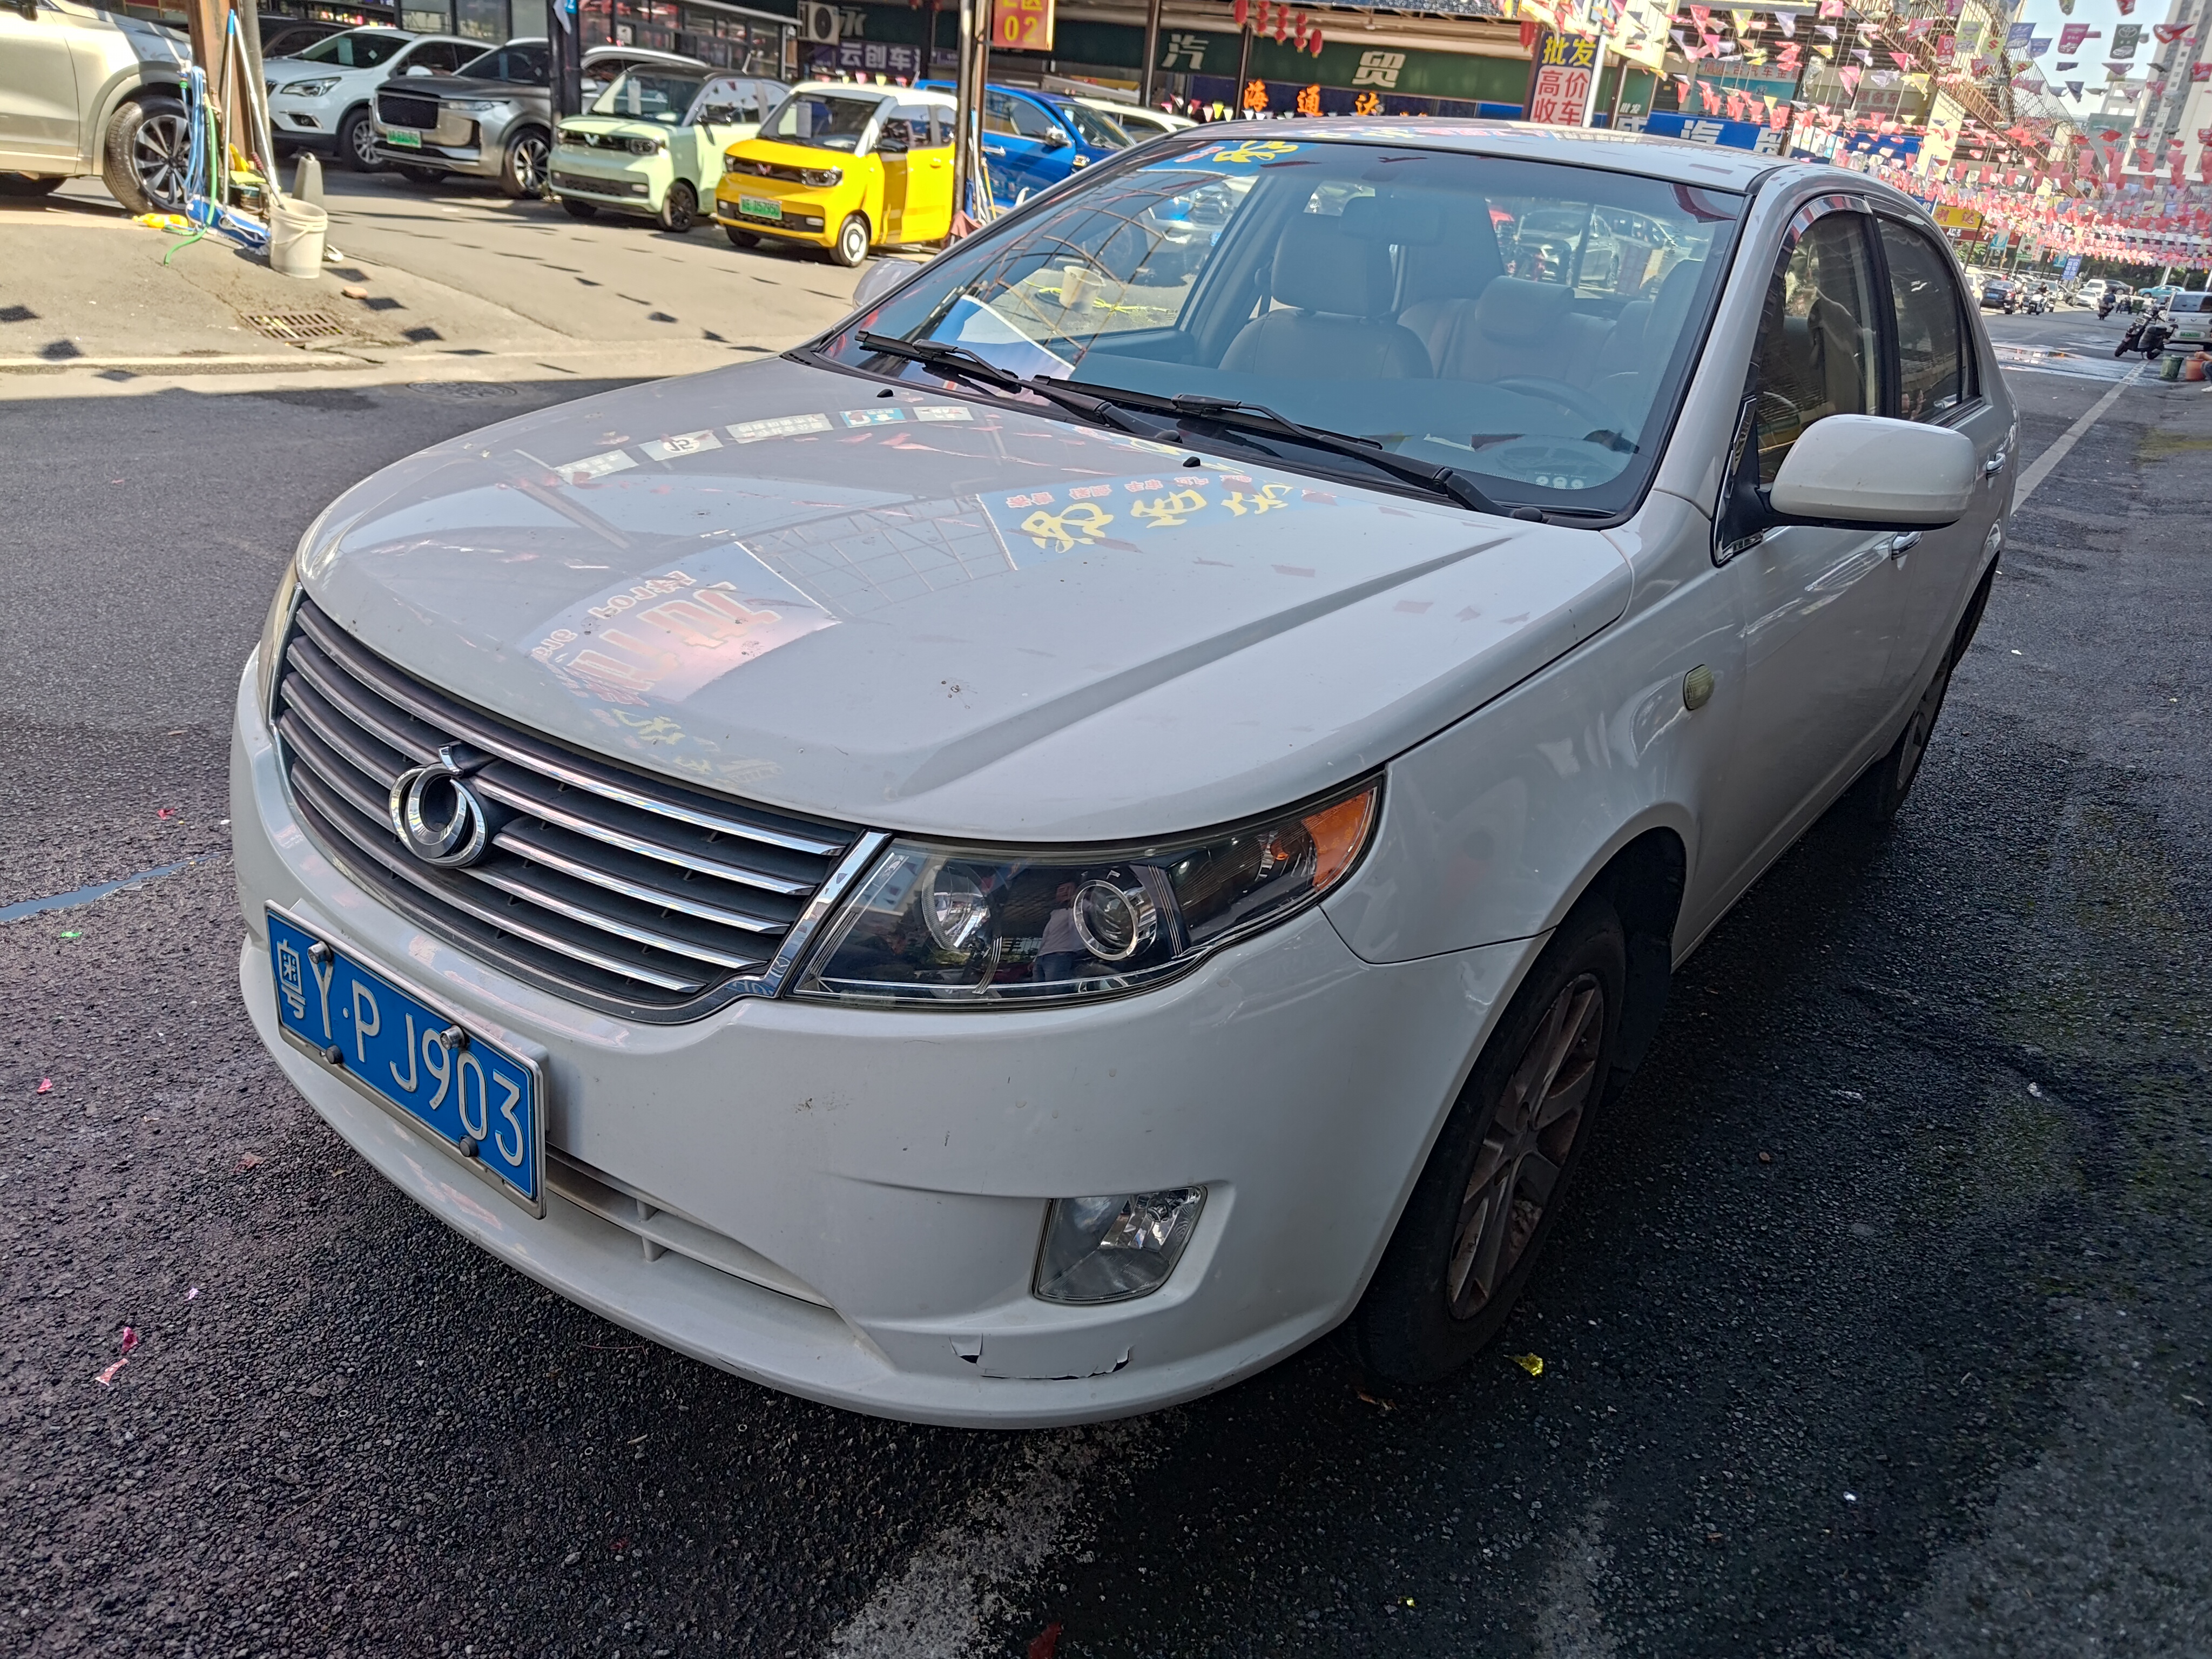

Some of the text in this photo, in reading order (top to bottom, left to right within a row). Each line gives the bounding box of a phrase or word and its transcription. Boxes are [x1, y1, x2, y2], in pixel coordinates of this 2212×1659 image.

[1003, 15, 1038, 43] 02
[1162, 34, 1209, 70] 汽
[1352, 51, 1406, 88] 贸
[1542, 36, 1596, 68] 批发
[1538, 70, 1588, 98] 高价
[1533, 98, 1582, 126] 收车
